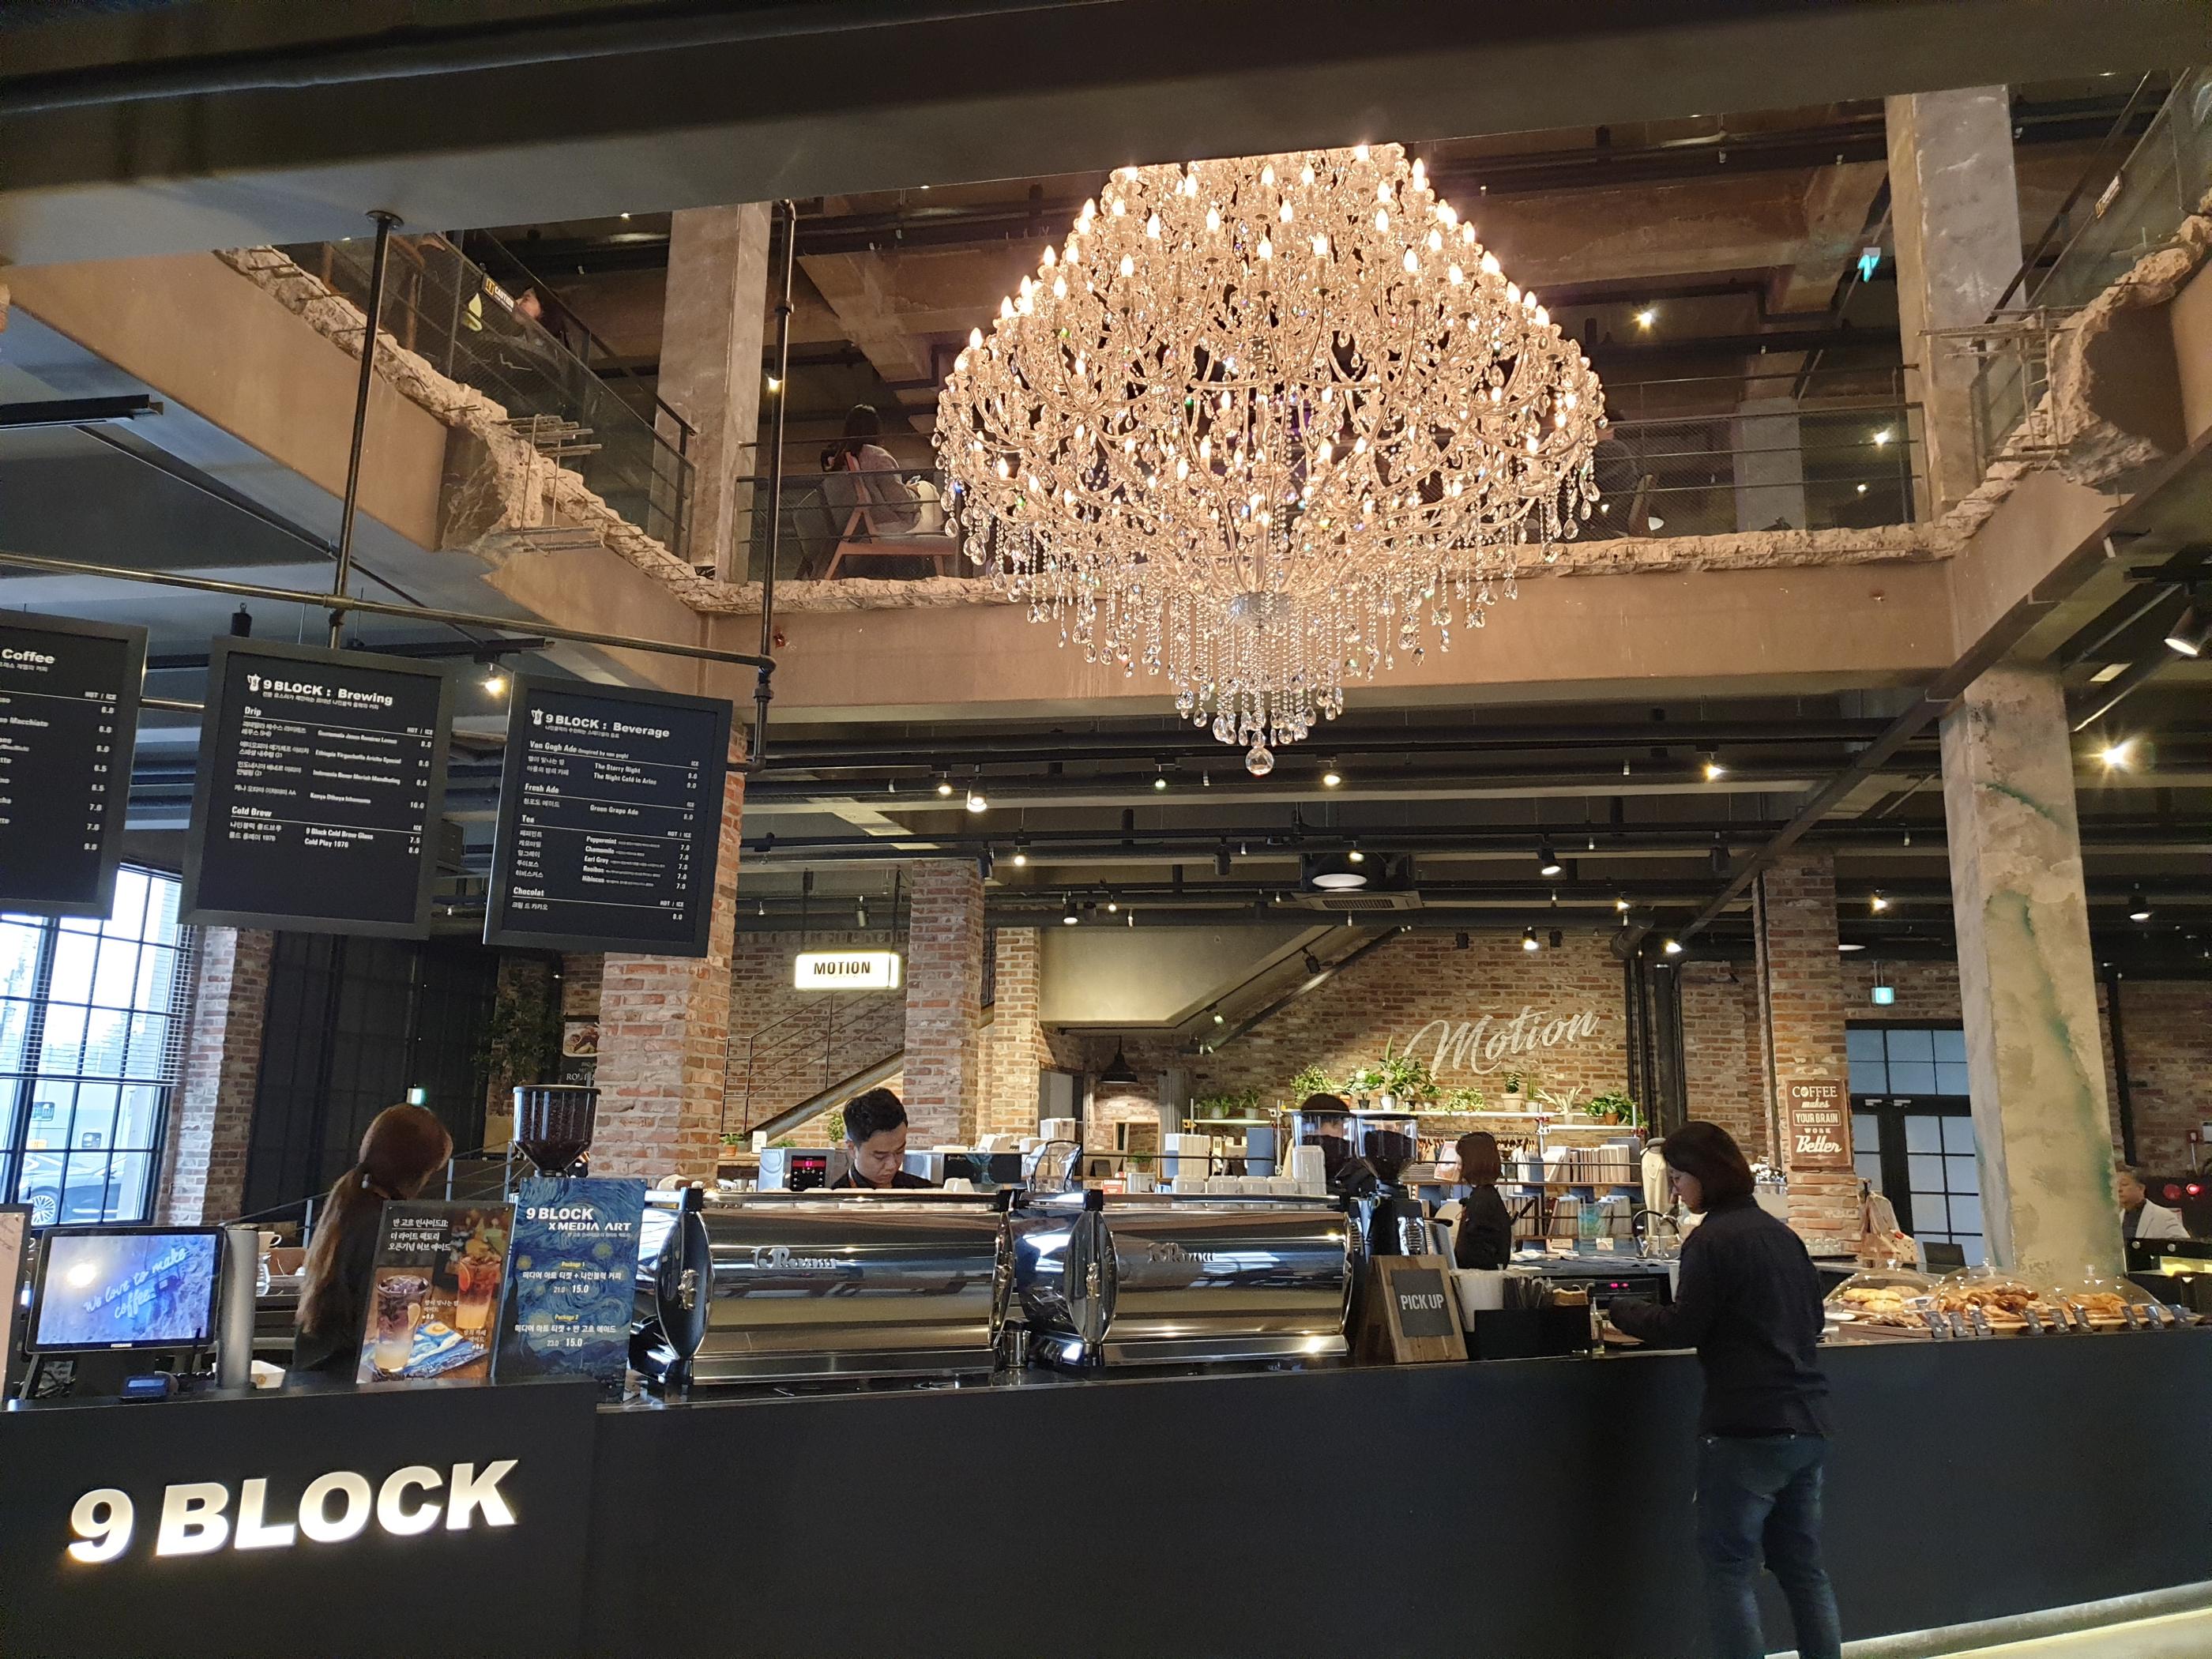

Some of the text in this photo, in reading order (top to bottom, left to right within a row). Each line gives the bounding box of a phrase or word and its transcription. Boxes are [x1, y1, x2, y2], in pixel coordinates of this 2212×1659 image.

[2, 649, 55, 664] Coffee
[263, 679, 272, 690] 9
[274, 680, 322, 696] BLOCK
[337, 688, 393, 705] Brewing
[244, 706, 261, 717] Drip
[546, 713, 553, 724] 9
[555, 715, 599, 729] BLOCK
[613, 722, 670, 738] Beverage
[529, 740, 577, 753] Van Gogh Ade
[606, 764, 624, 773] Starry
[525, 783, 544, 792] Fresh
[231, 806, 272, 817] Cold Brew
[521, 814, 534, 823] Tea
[318, 839, 333, 848] Play
[513, 886, 544, 897] Chocolat
[814, 961, 871, 975] MOTION
[1402, 1005, 1601, 1080] Motion
[1792, 1086, 1838, 1097] COFFEE
[1801, 1098, 1830, 1108] makes
[1796, 1113, 1838, 1123] YOUR BRAIN
[1794, 1135, 1842, 1153] Better
[526, 1207, 594, 1220] 9 BLOCK
[604, 1222, 632, 1231] ART
[105, 1280, 130, 1303] love
[133, 1270, 149, 1285] to
[152, 1247, 189, 1273] make
[522, 1271, 543, 1280] 미디어
[544, 1271, 557, 1280] 아트
[559, 1271, 573, 1280] 티켓
[572, 1285, 589, 1293] 15.0
[115, 1288, 156, 1319] coffee
[1400, 1293, 1445, 1310] PICK UP
[514, 1324, 535, 1333] 미디어
[536, 1324, 549, 1333] 아트
[551, 1324, 565, 1333] 티켓
[596, 1325, 616, 1334] 에이드
[566, 1338, 583, 1347] 15.0
[68, 1459, 518, 1563] 9 BLOCK
